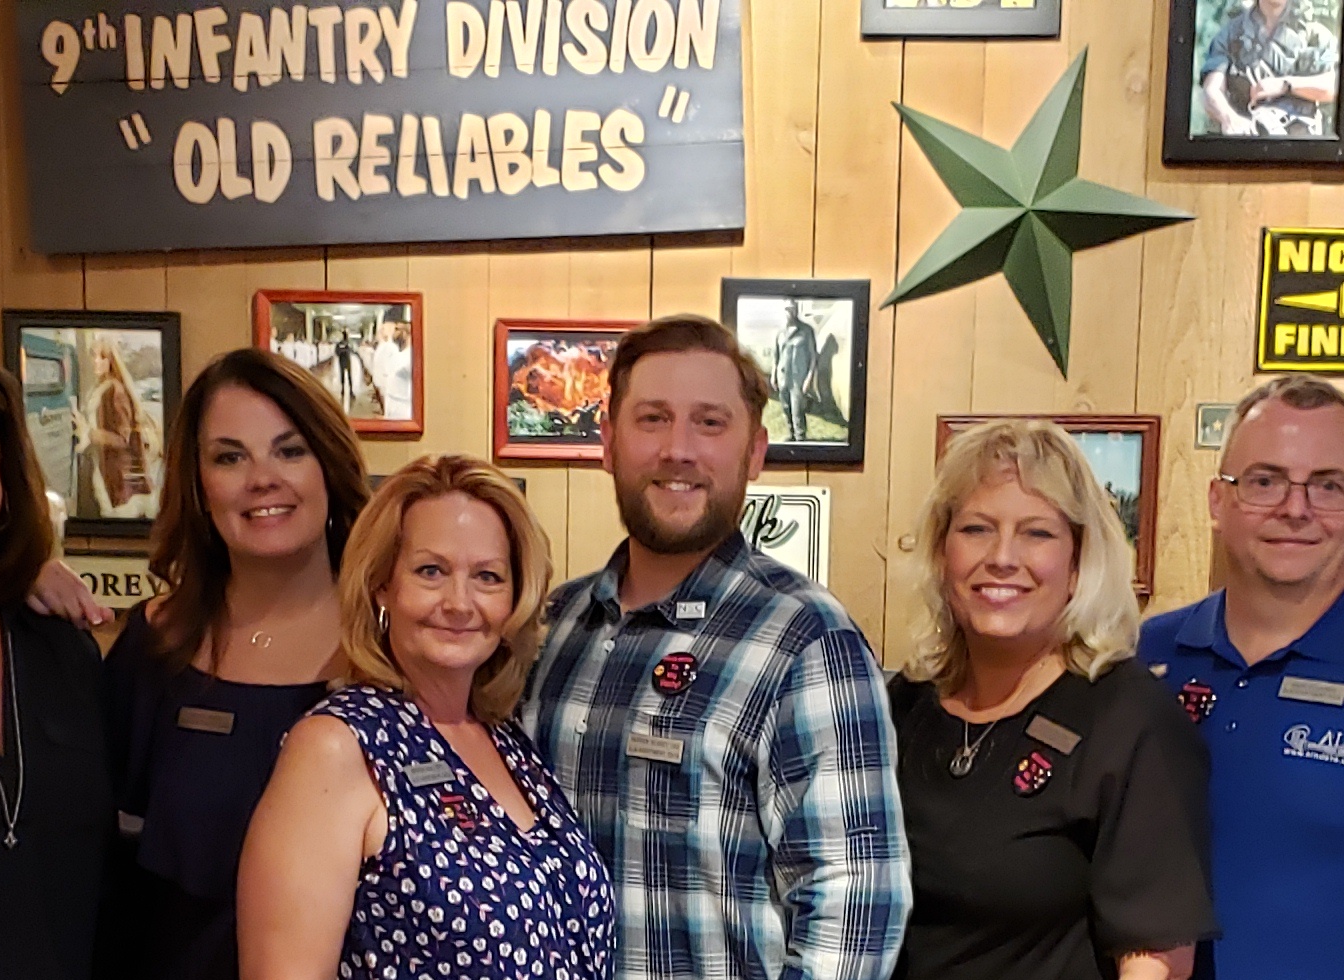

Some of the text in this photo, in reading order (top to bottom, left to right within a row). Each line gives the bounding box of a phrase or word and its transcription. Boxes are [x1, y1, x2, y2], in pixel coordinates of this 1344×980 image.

[41, 0, 721, 95] 9th INFANTRY DIVISION
